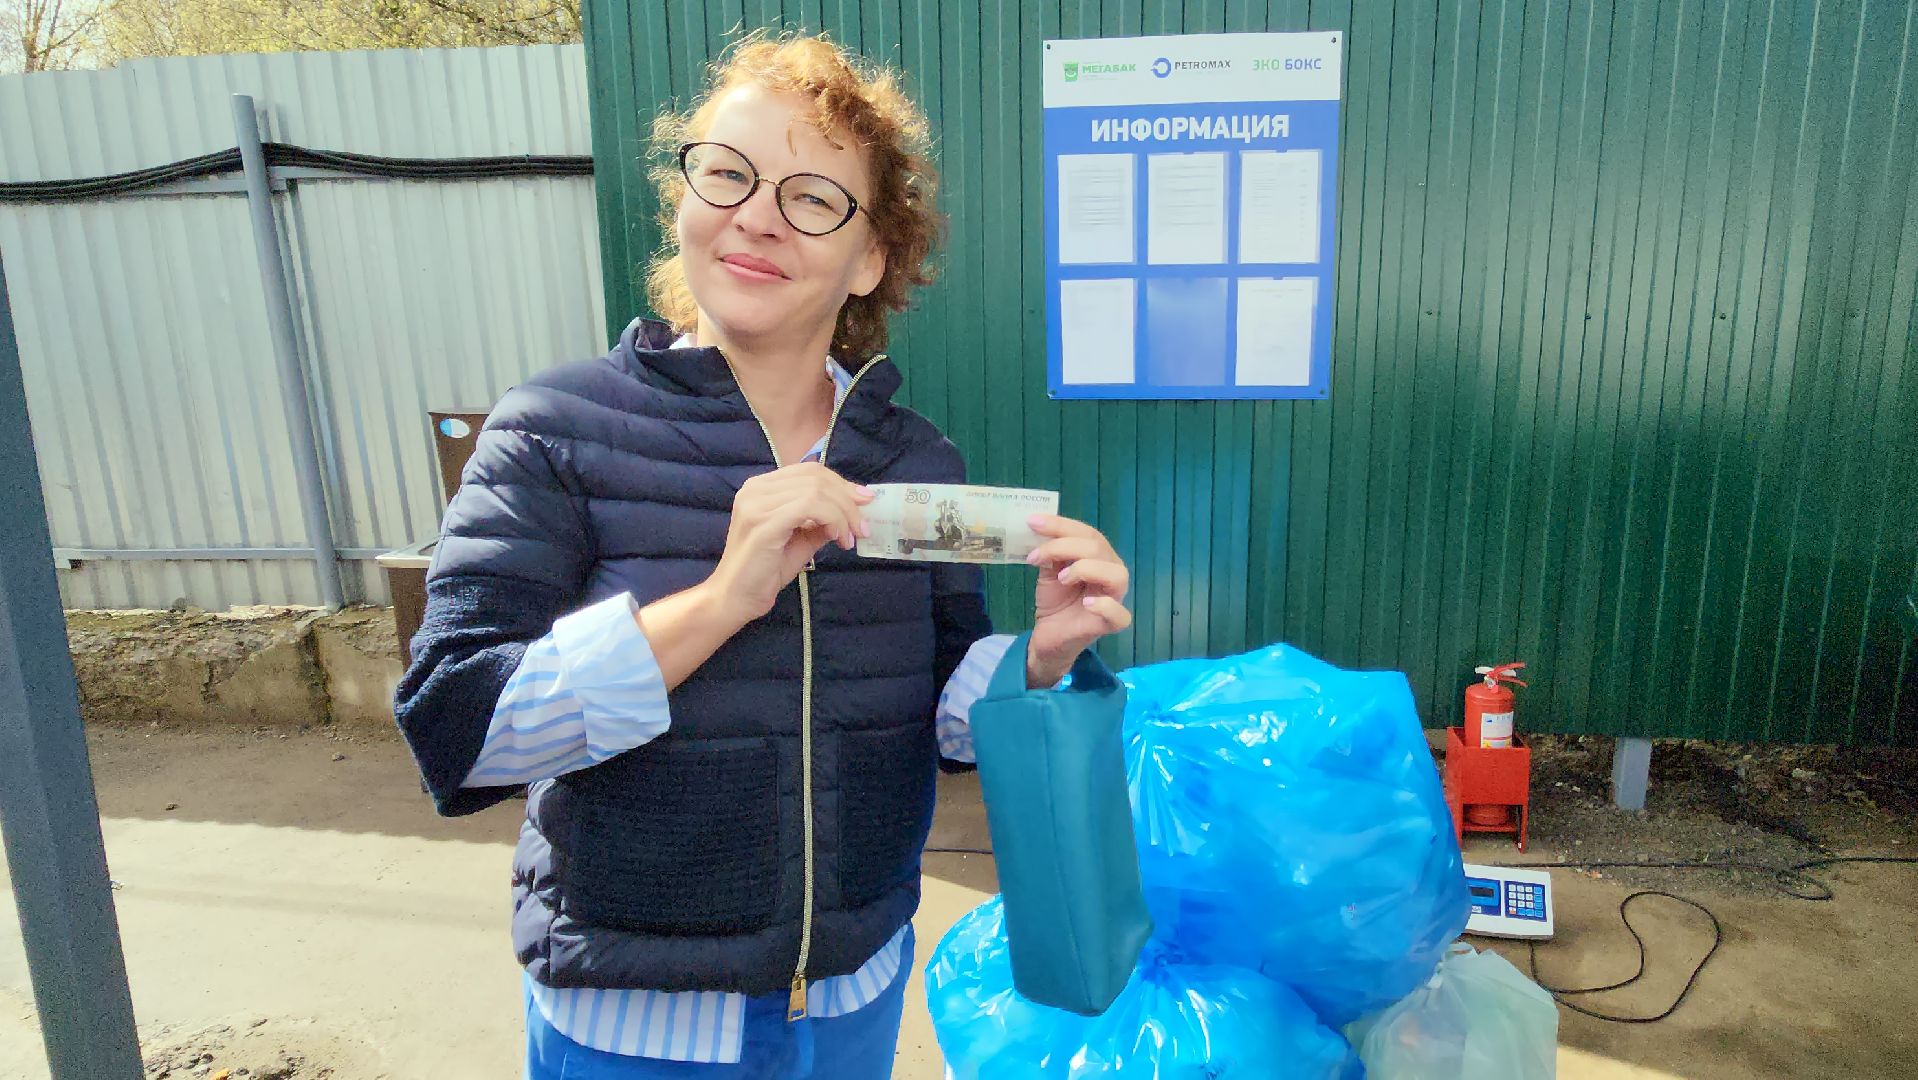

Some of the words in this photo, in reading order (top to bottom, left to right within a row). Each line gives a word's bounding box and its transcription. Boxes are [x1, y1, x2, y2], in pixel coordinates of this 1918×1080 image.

[1174, 59, 1231, 70] PETROMAX
[1284, 57, 1322, 70] БОКС
[1091, 114, 1289, 143] ИНФОРМАЦИЯ
[905, 488, 931, 504] 50
